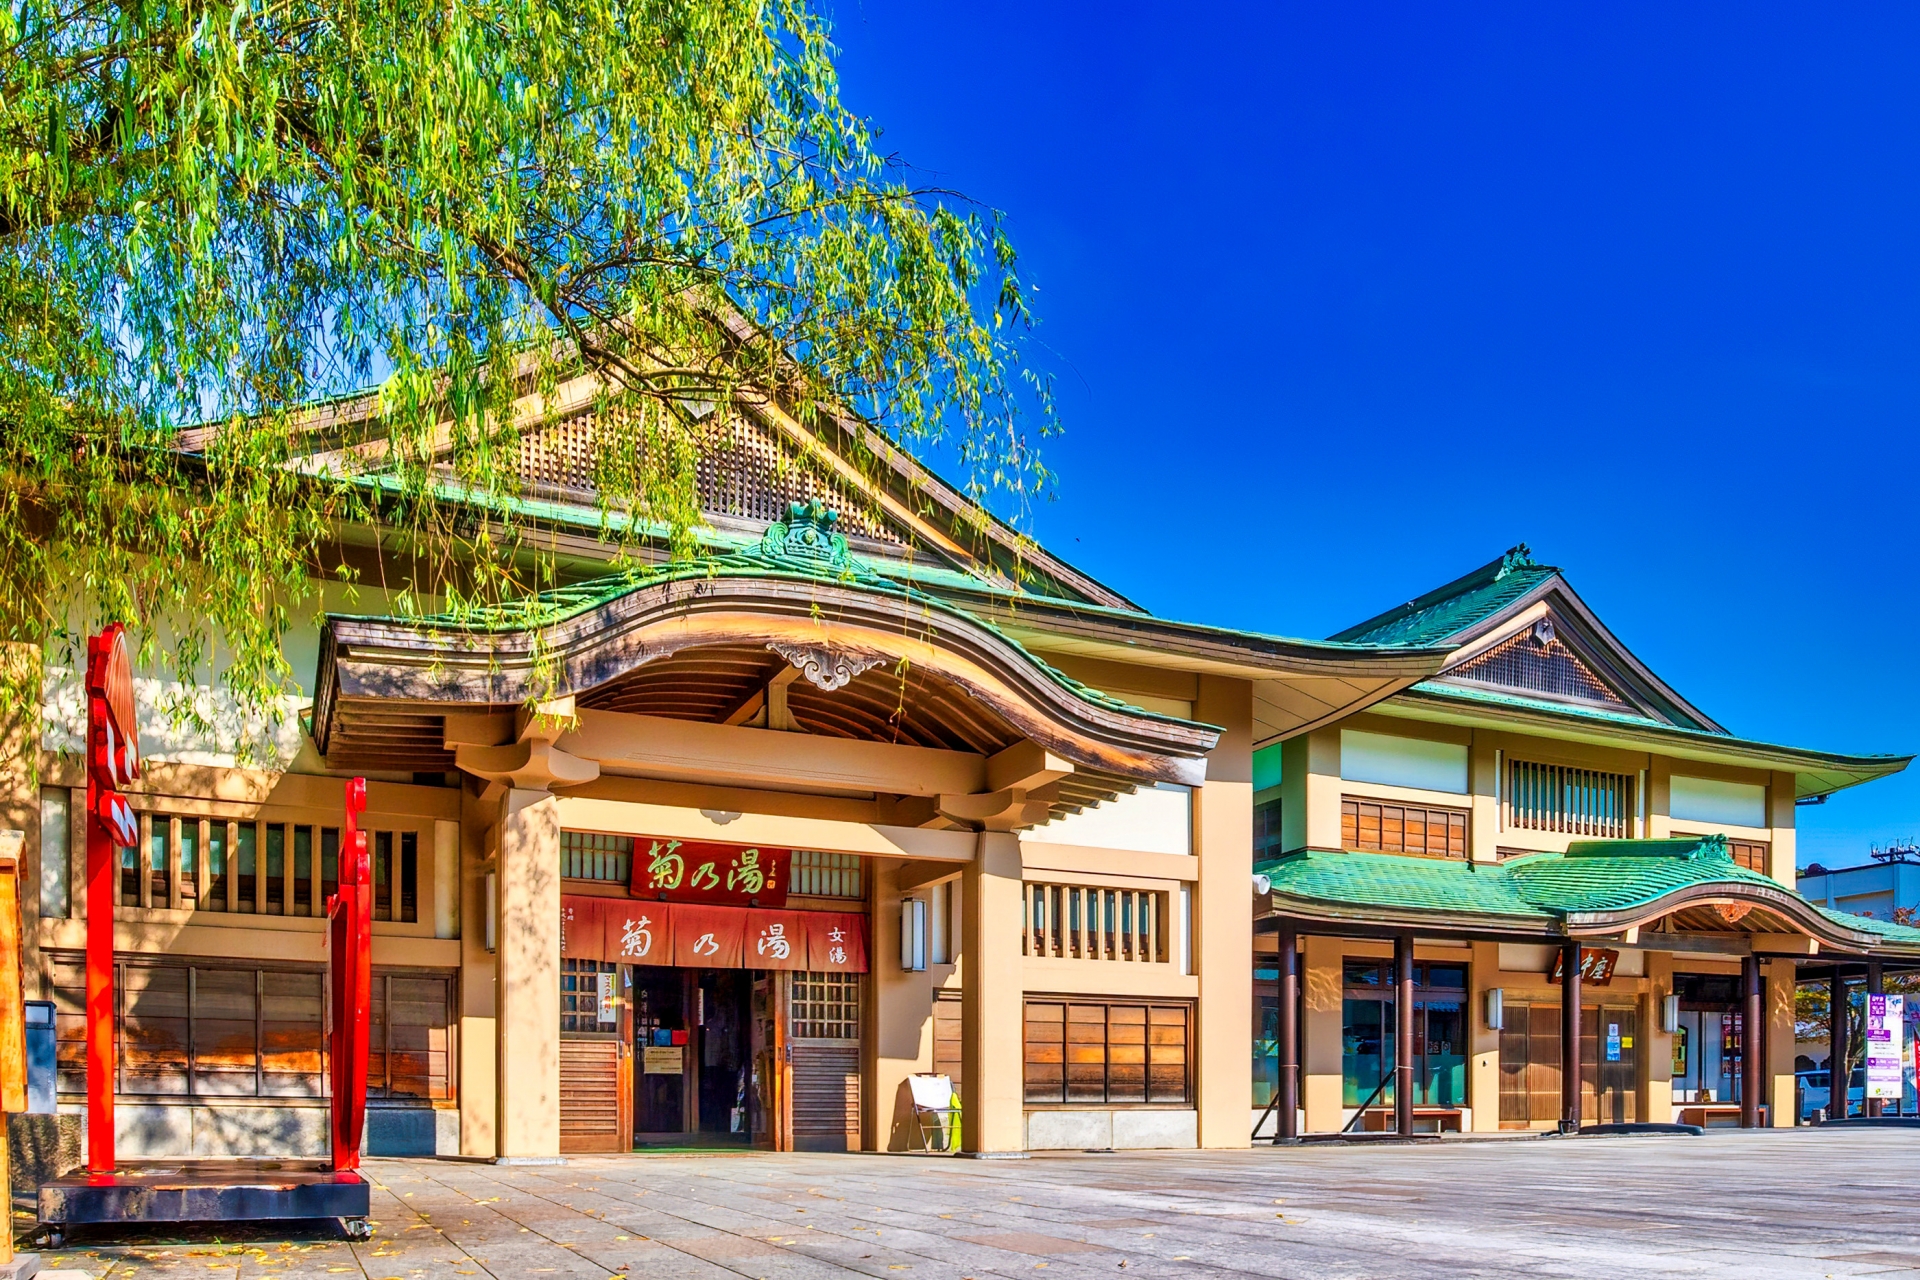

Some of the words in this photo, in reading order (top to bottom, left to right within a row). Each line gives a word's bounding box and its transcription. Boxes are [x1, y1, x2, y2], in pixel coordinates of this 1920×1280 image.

[648, 840, 764, 893] 菊乃湯
[620, 915, 791, 960] 菊乃湯
[827, 926, 847, 965] 女湯
